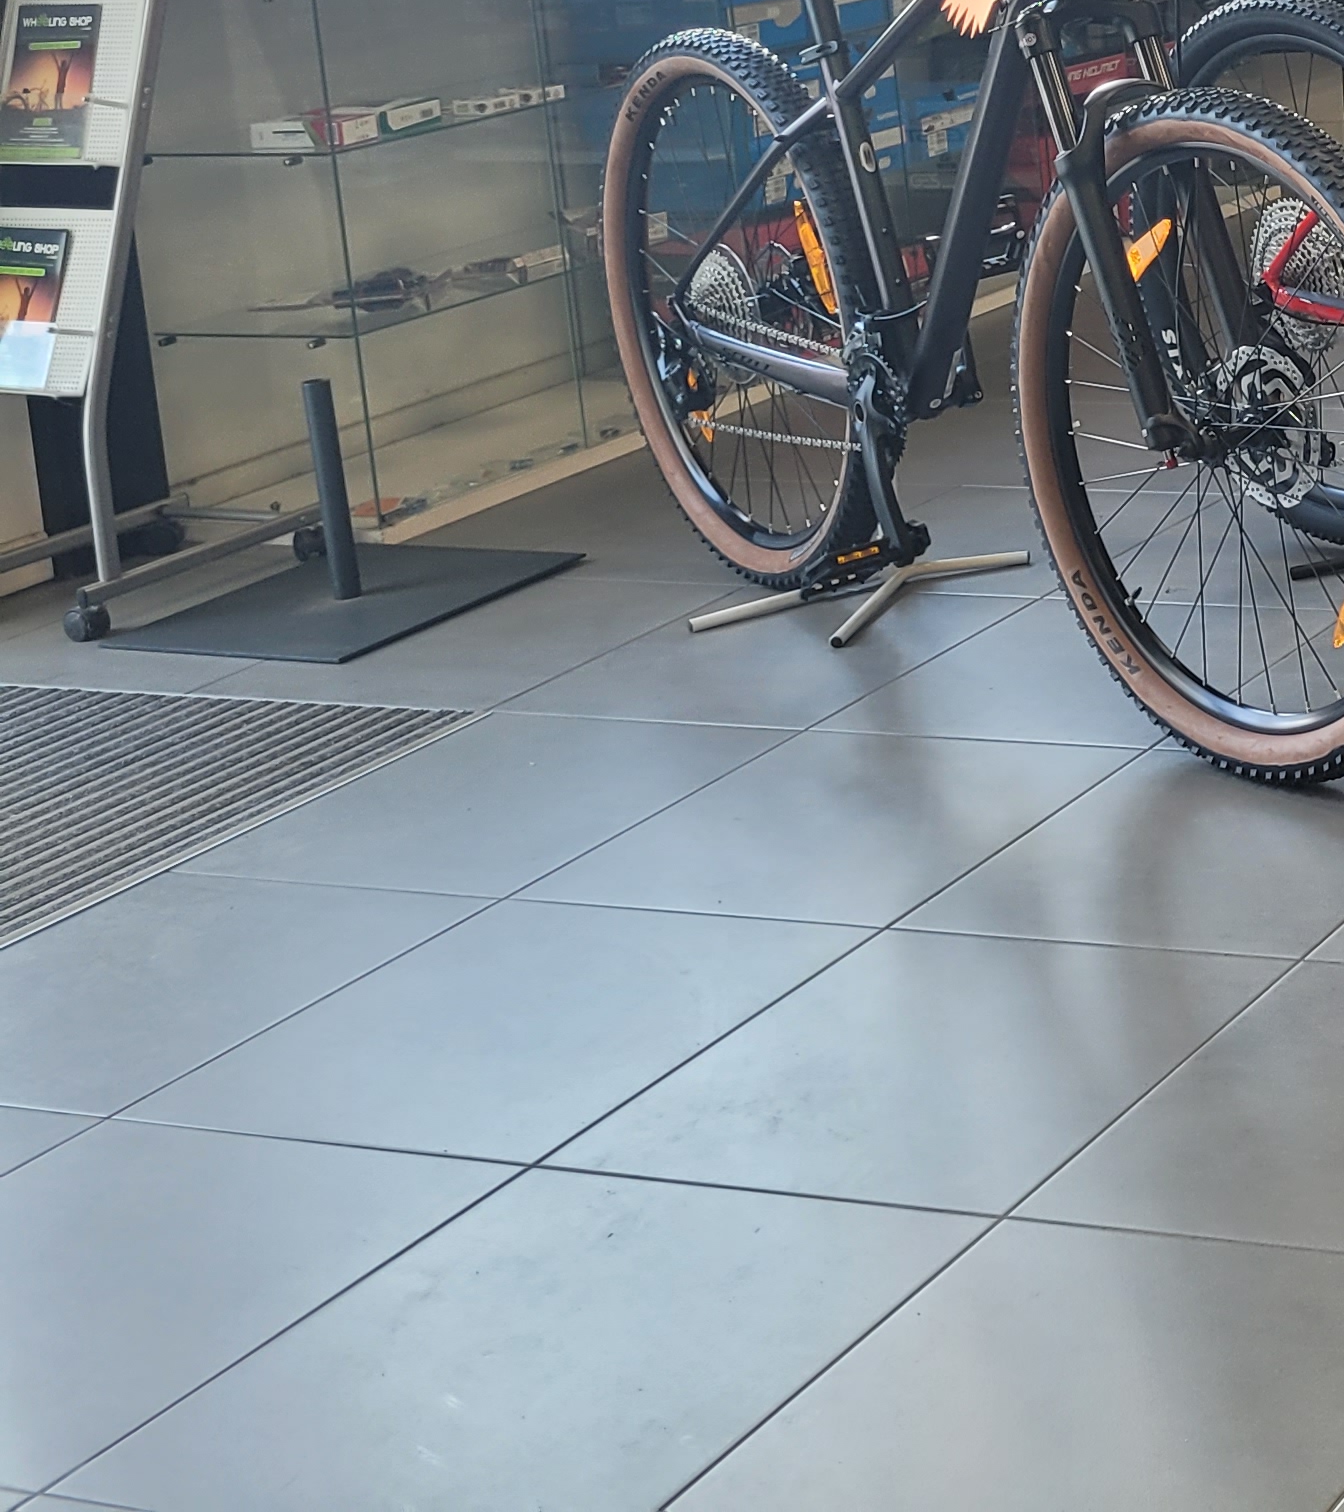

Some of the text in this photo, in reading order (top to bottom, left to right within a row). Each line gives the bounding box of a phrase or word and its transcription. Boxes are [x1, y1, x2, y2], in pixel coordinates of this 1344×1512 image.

[69, 15, 93, 27] SHOP
[624, 70, 668, 123] KENDA
[34, 242, 60, 254] SHOP
[1071, 569, 1142, 675] KENDA
